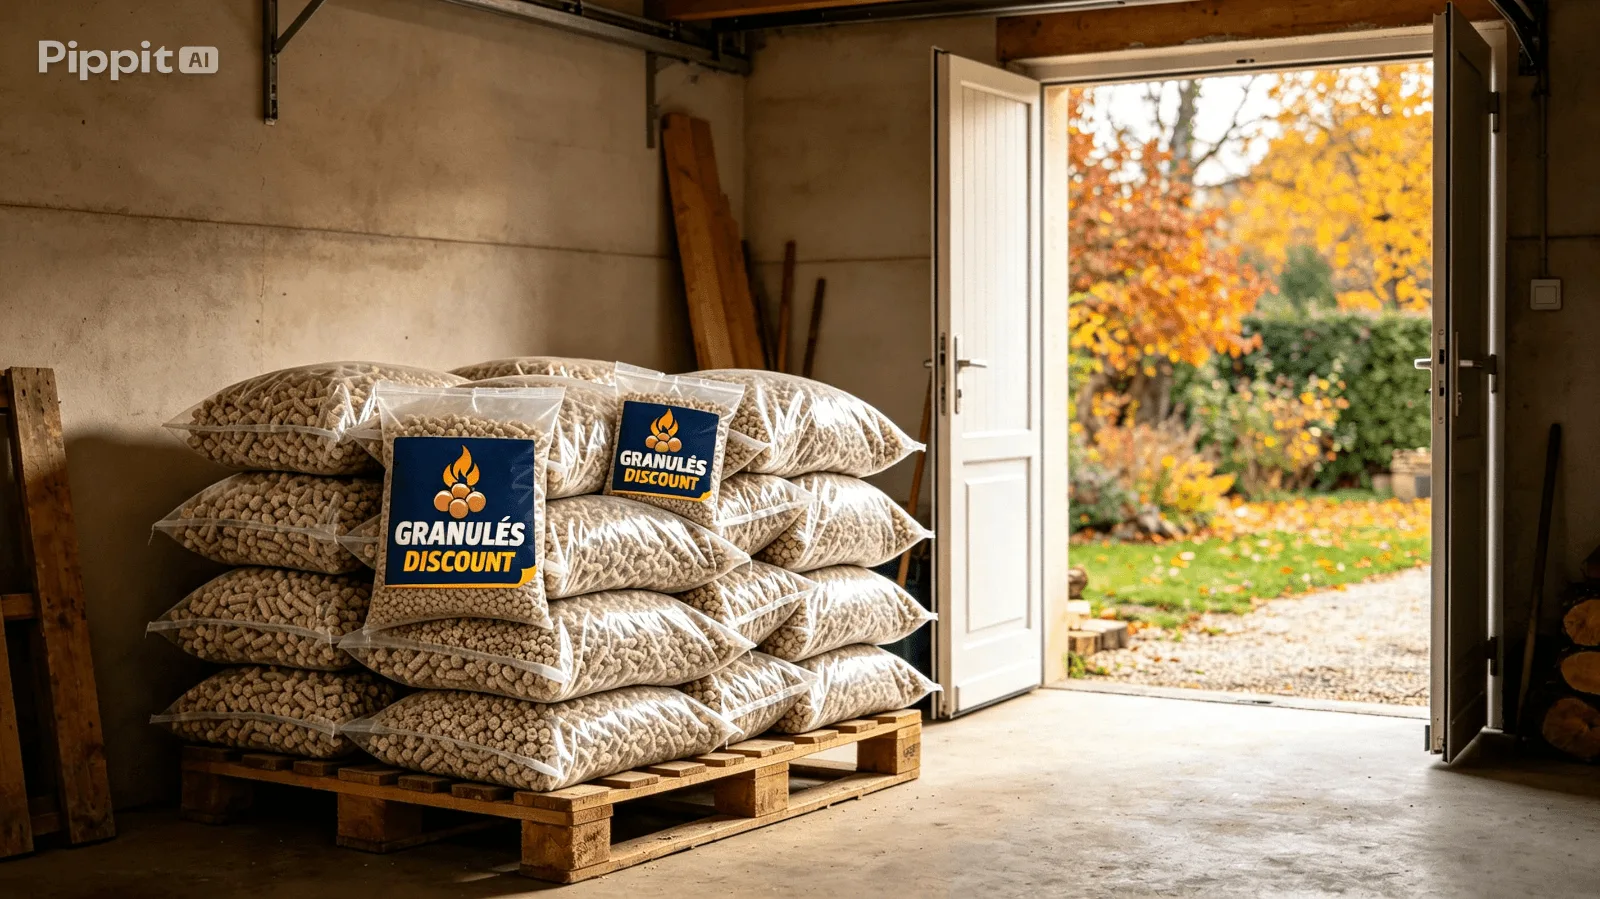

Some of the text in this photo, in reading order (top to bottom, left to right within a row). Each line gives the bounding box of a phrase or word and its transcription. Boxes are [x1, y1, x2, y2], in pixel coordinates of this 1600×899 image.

[620, 450, 708, 477] GRANULÉS
[623, 468, 700, 491] DISCOUNT
[394, 515, 526, 547] GRANULÉS
[403, 550, 517, 573] DISCOUNT
